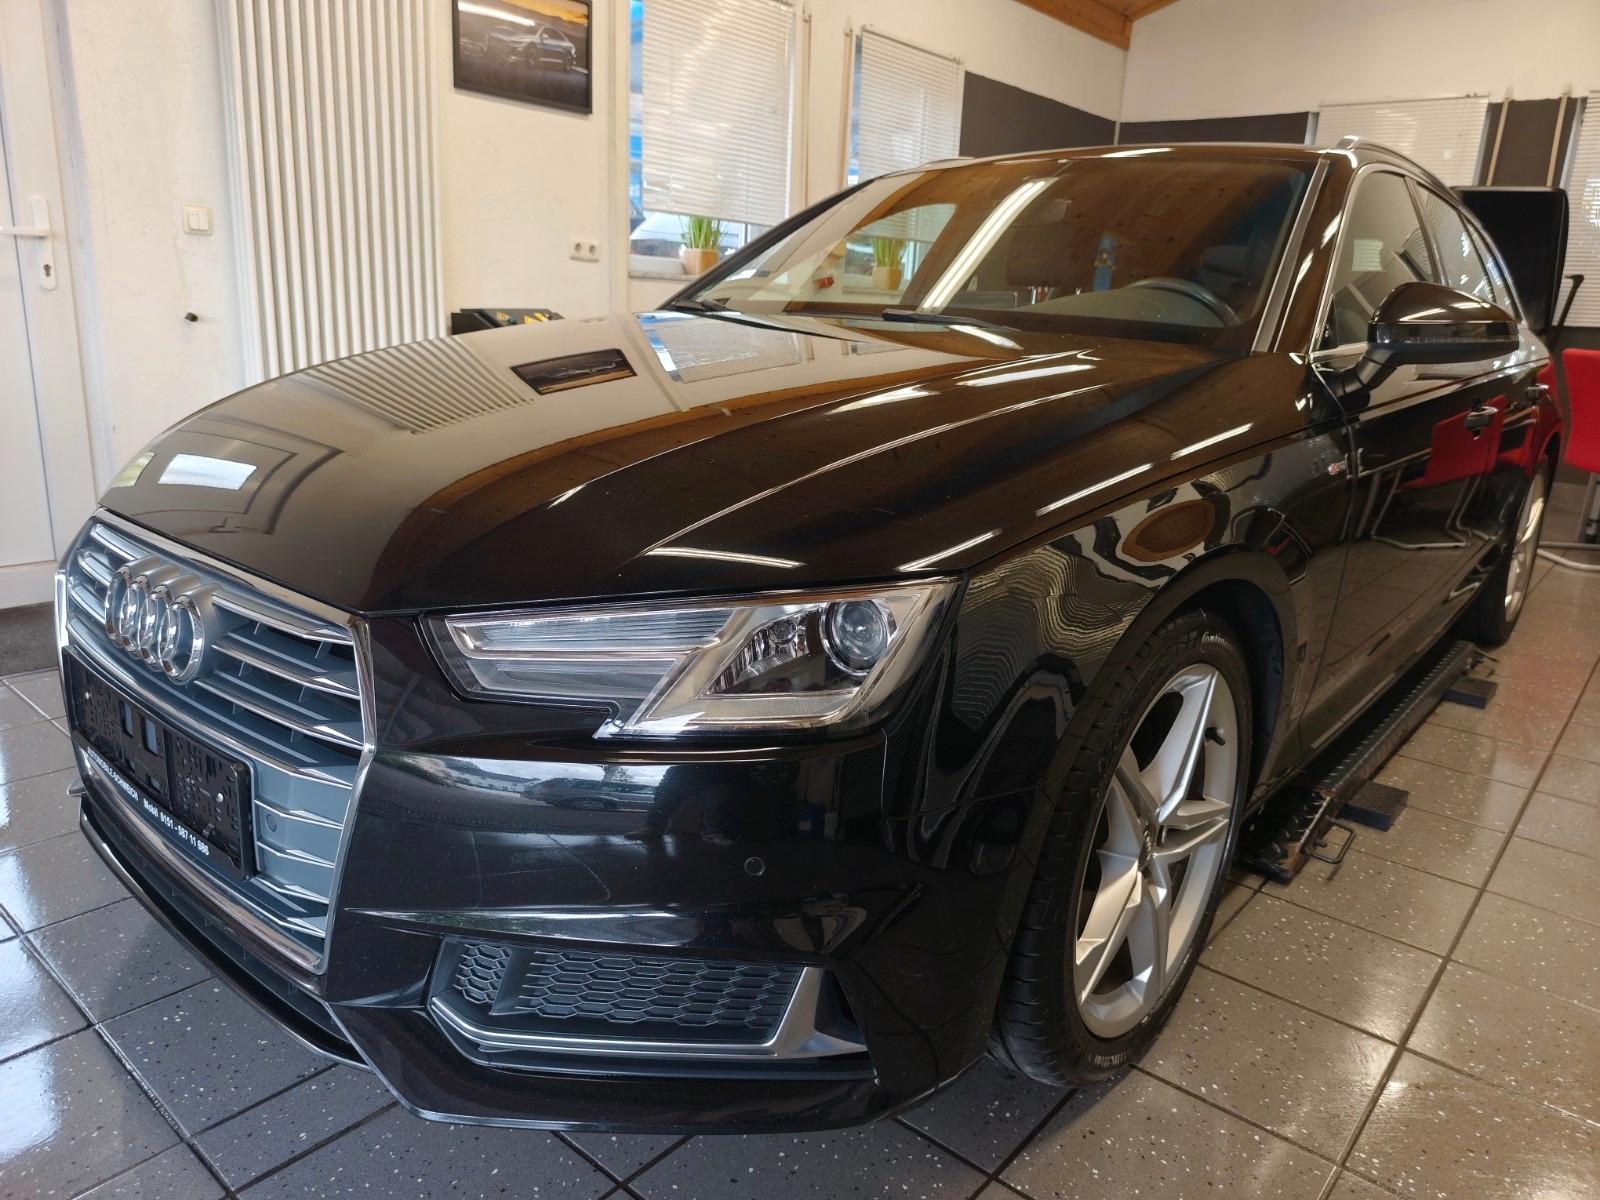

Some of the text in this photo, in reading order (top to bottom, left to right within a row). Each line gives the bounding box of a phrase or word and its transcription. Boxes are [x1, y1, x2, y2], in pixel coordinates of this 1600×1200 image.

[143, 798, 158, 818] Mobil
[160, 811, 174, 829] 0151
[189, 834, 197, 847] 11
